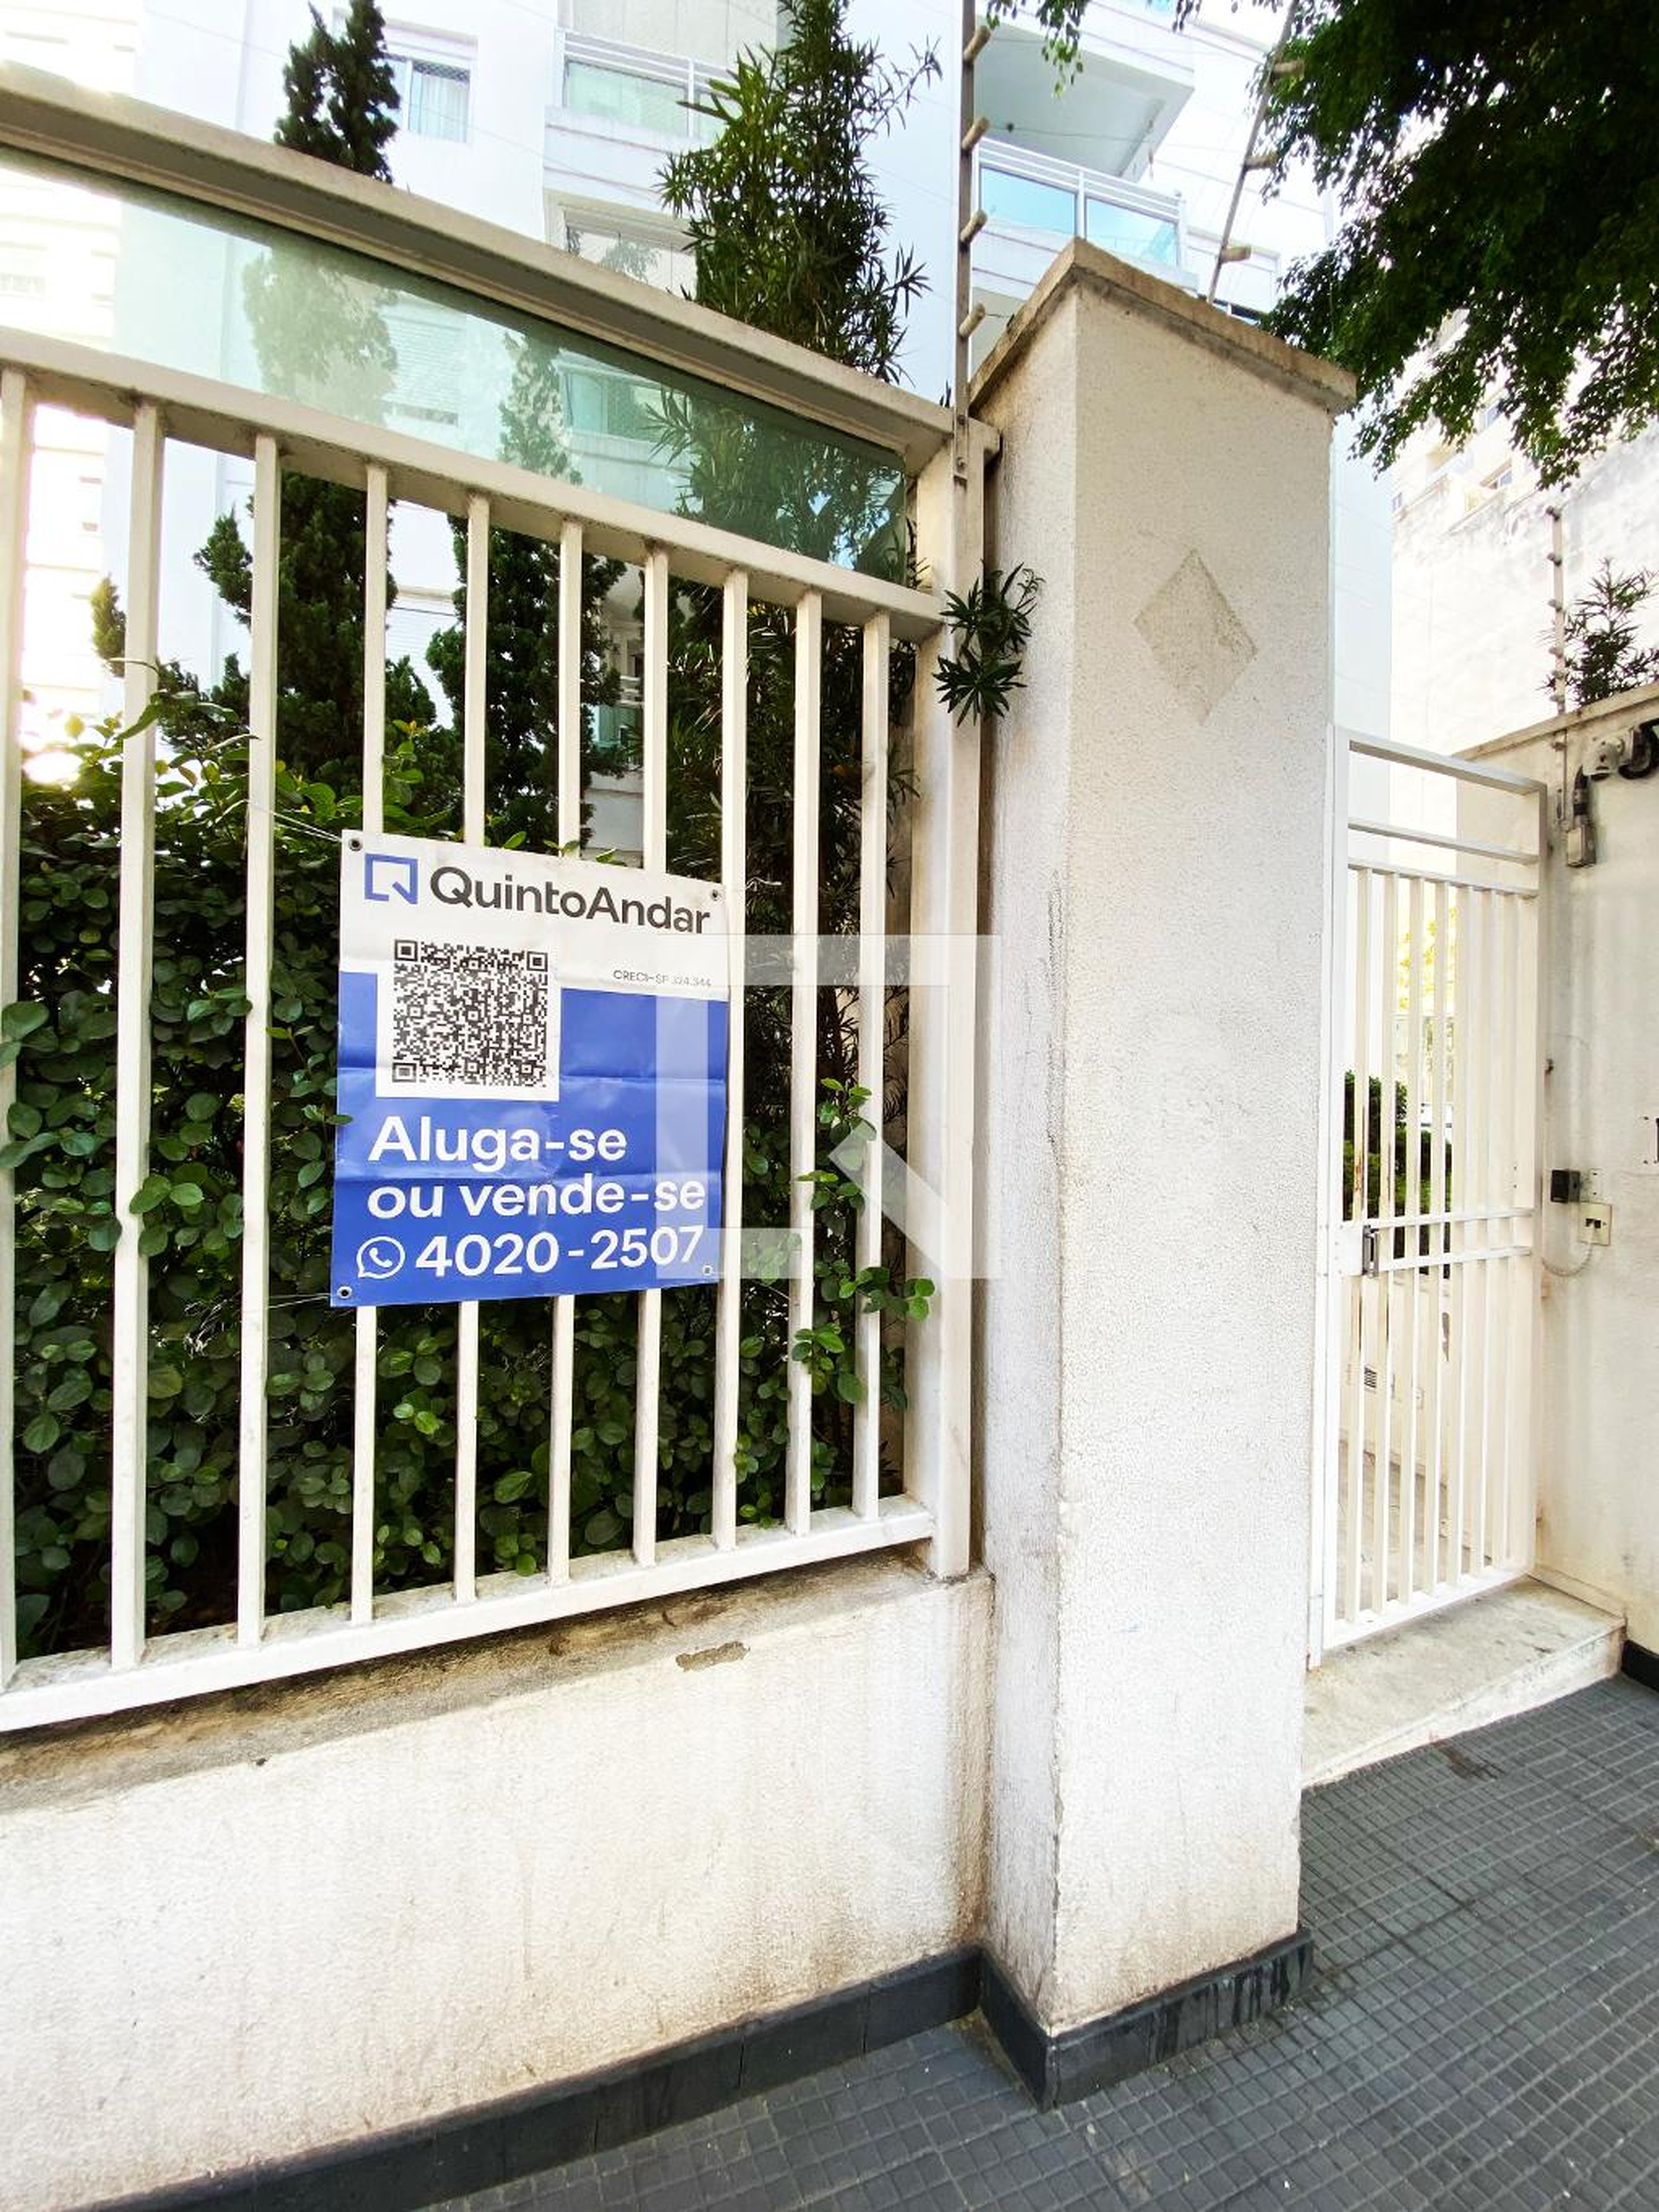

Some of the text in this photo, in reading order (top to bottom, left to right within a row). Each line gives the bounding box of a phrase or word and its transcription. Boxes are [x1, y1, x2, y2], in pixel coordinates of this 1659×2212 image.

[430, 866, 710, 934] QuintoAndar
[368, 1116, 627, 1172] Aluga-se
[367, 1173, 705, 1219] ou vende-se
[415, 1225, 704, 1277] 4020-2507
